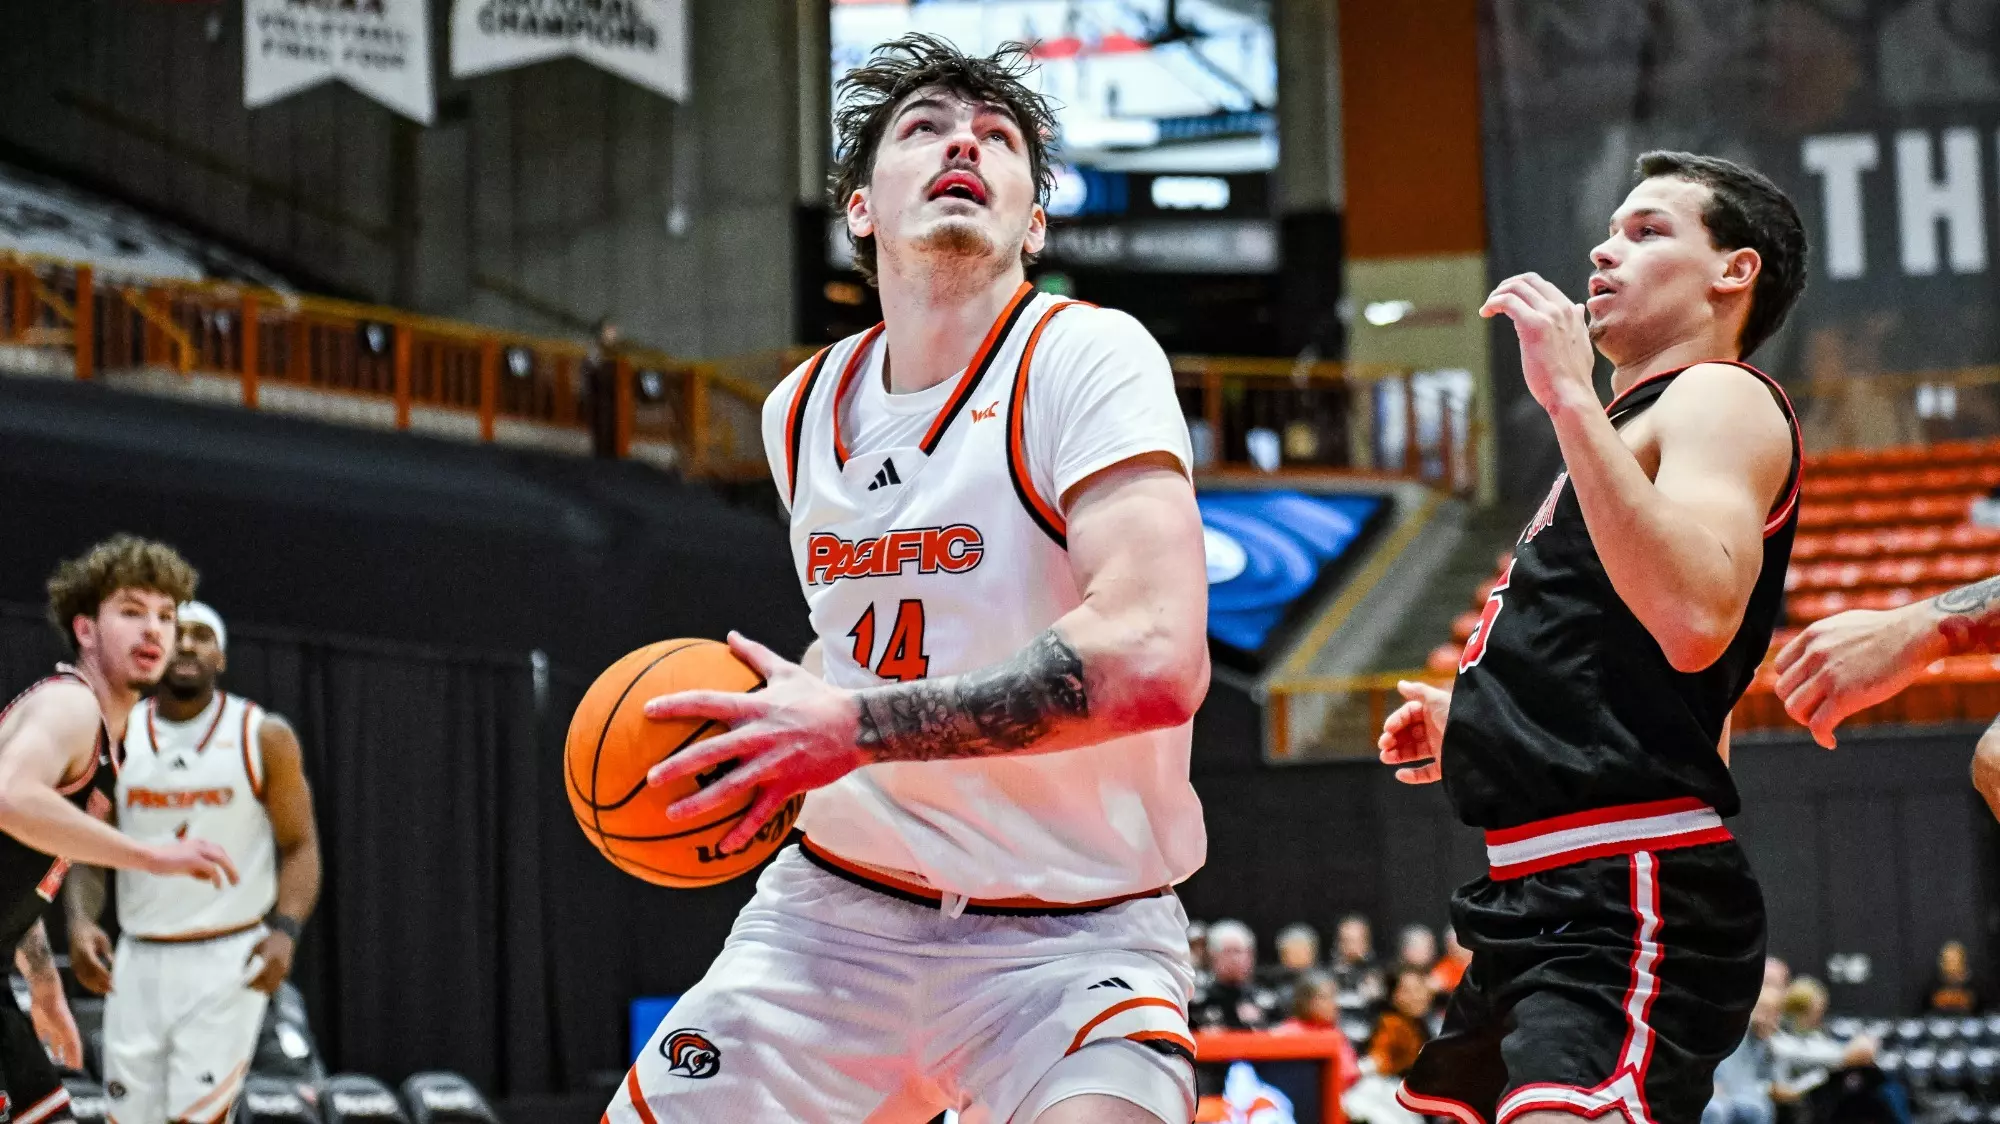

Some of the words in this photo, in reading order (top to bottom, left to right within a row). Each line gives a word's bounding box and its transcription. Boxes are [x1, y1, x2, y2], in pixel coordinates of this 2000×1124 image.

[1802, 127, 2000, 279] TH
[806, 524, 984, 586] PACIFIC
[847, 599, 929, 683] 14
